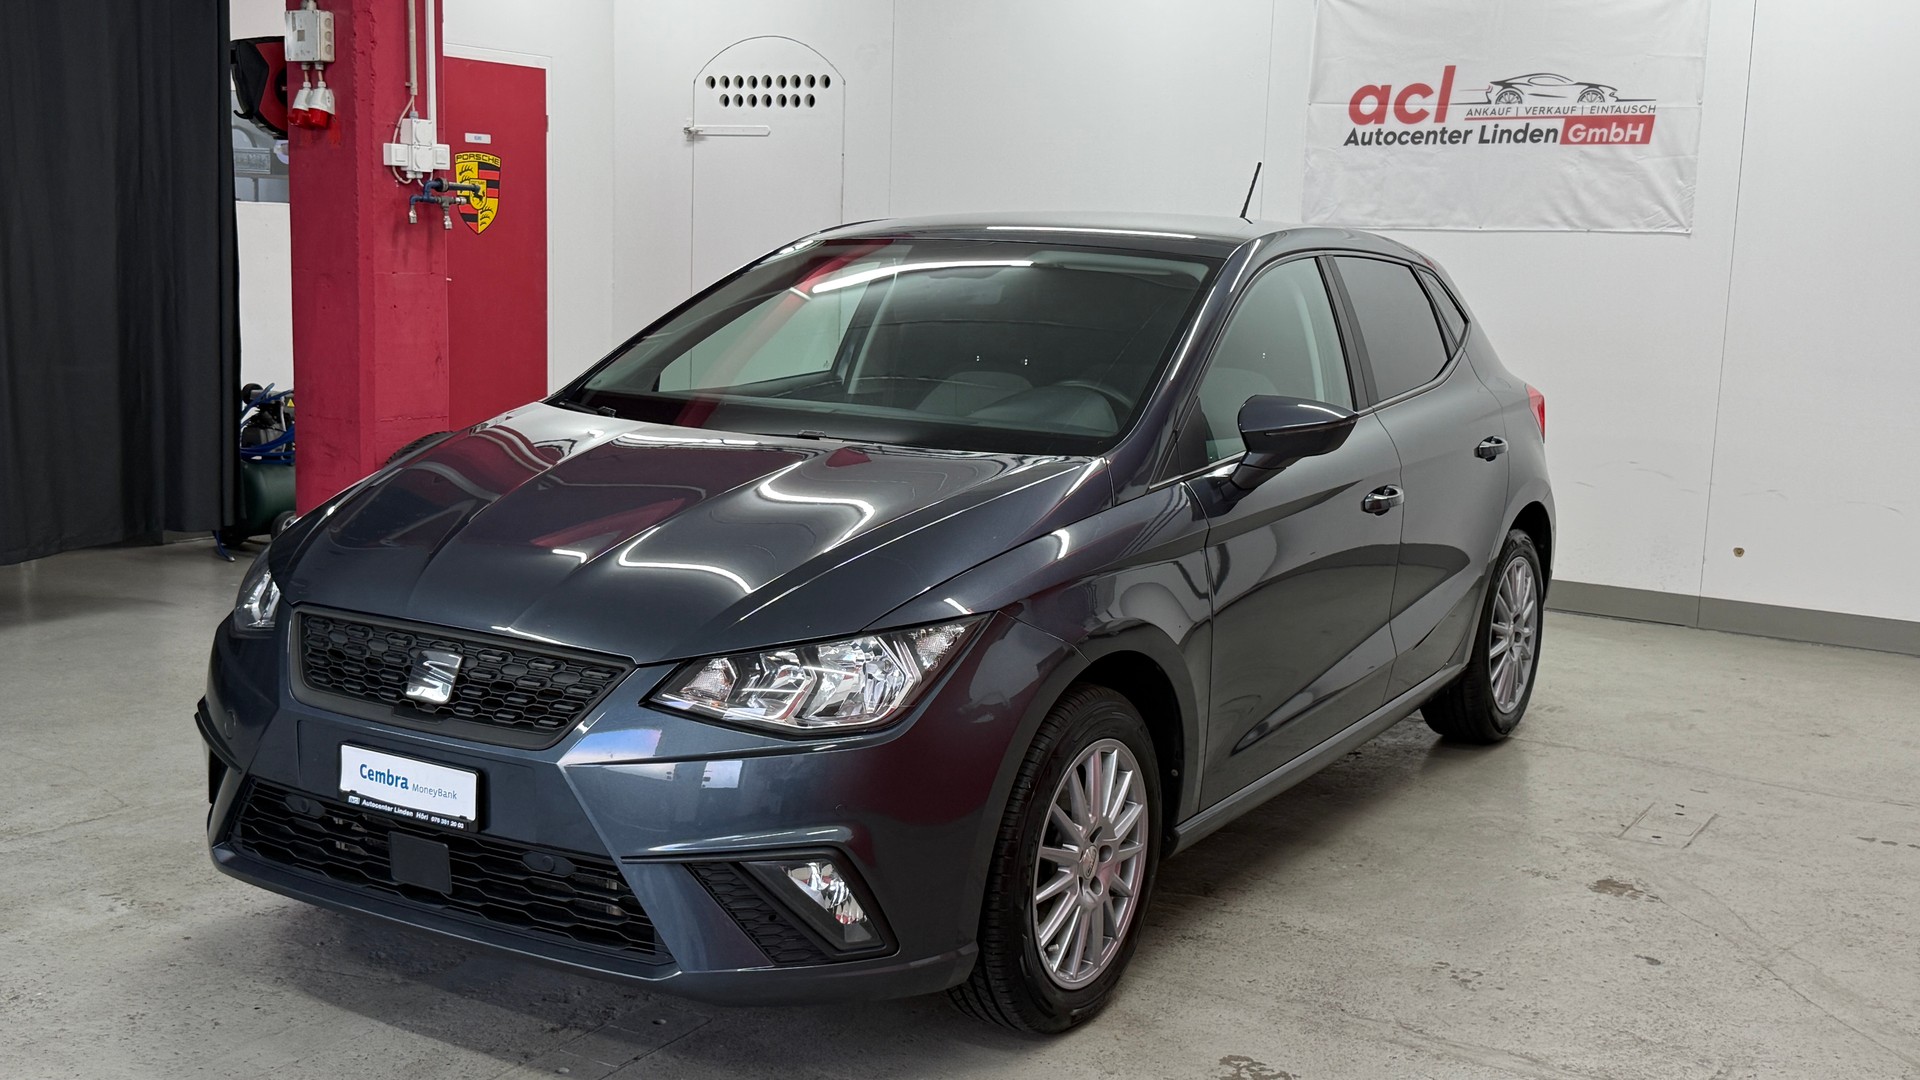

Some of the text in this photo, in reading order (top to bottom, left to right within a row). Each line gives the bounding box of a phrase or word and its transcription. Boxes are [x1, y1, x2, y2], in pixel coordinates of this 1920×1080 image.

[1348, 65, 1456, 126] acl
[1466, 104, 1657, 117] ANKAUF VERKAUF EINTAUSCH
[1343, 122, 1644, 147] Autocenter Linden GmbH
[456, 153, 500, 164] PORSCHE
[360, 764, 409, 790] Cembra
[412, 783, 457, 799] MoneyBank
[361, 799, 393, 812] Autocenter
[394, 806, 414, 817] Linden
